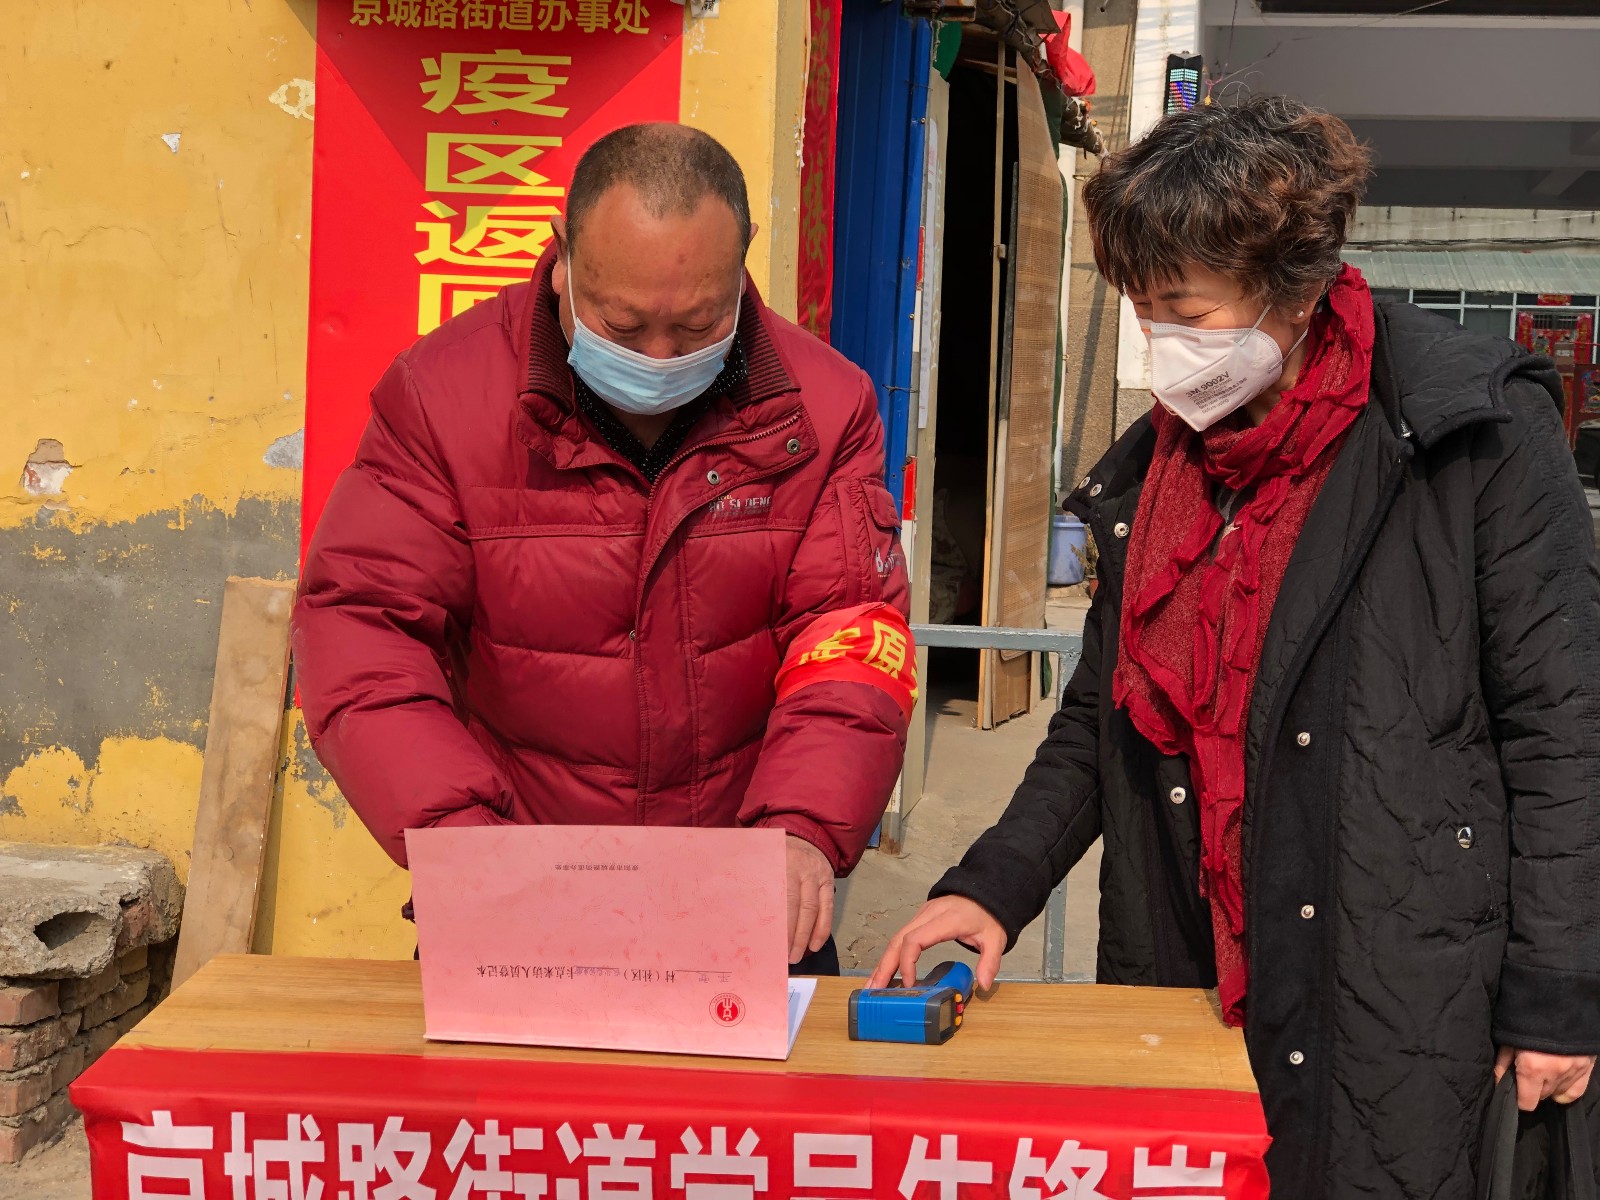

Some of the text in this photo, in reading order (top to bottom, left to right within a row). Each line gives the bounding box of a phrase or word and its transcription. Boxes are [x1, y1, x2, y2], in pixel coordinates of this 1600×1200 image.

[1186, 388, 1201, 398] 3M
[1201, 371, 1230, 390] 9002V
[476, 964, 574, 980] 卡点来访人员登记本
